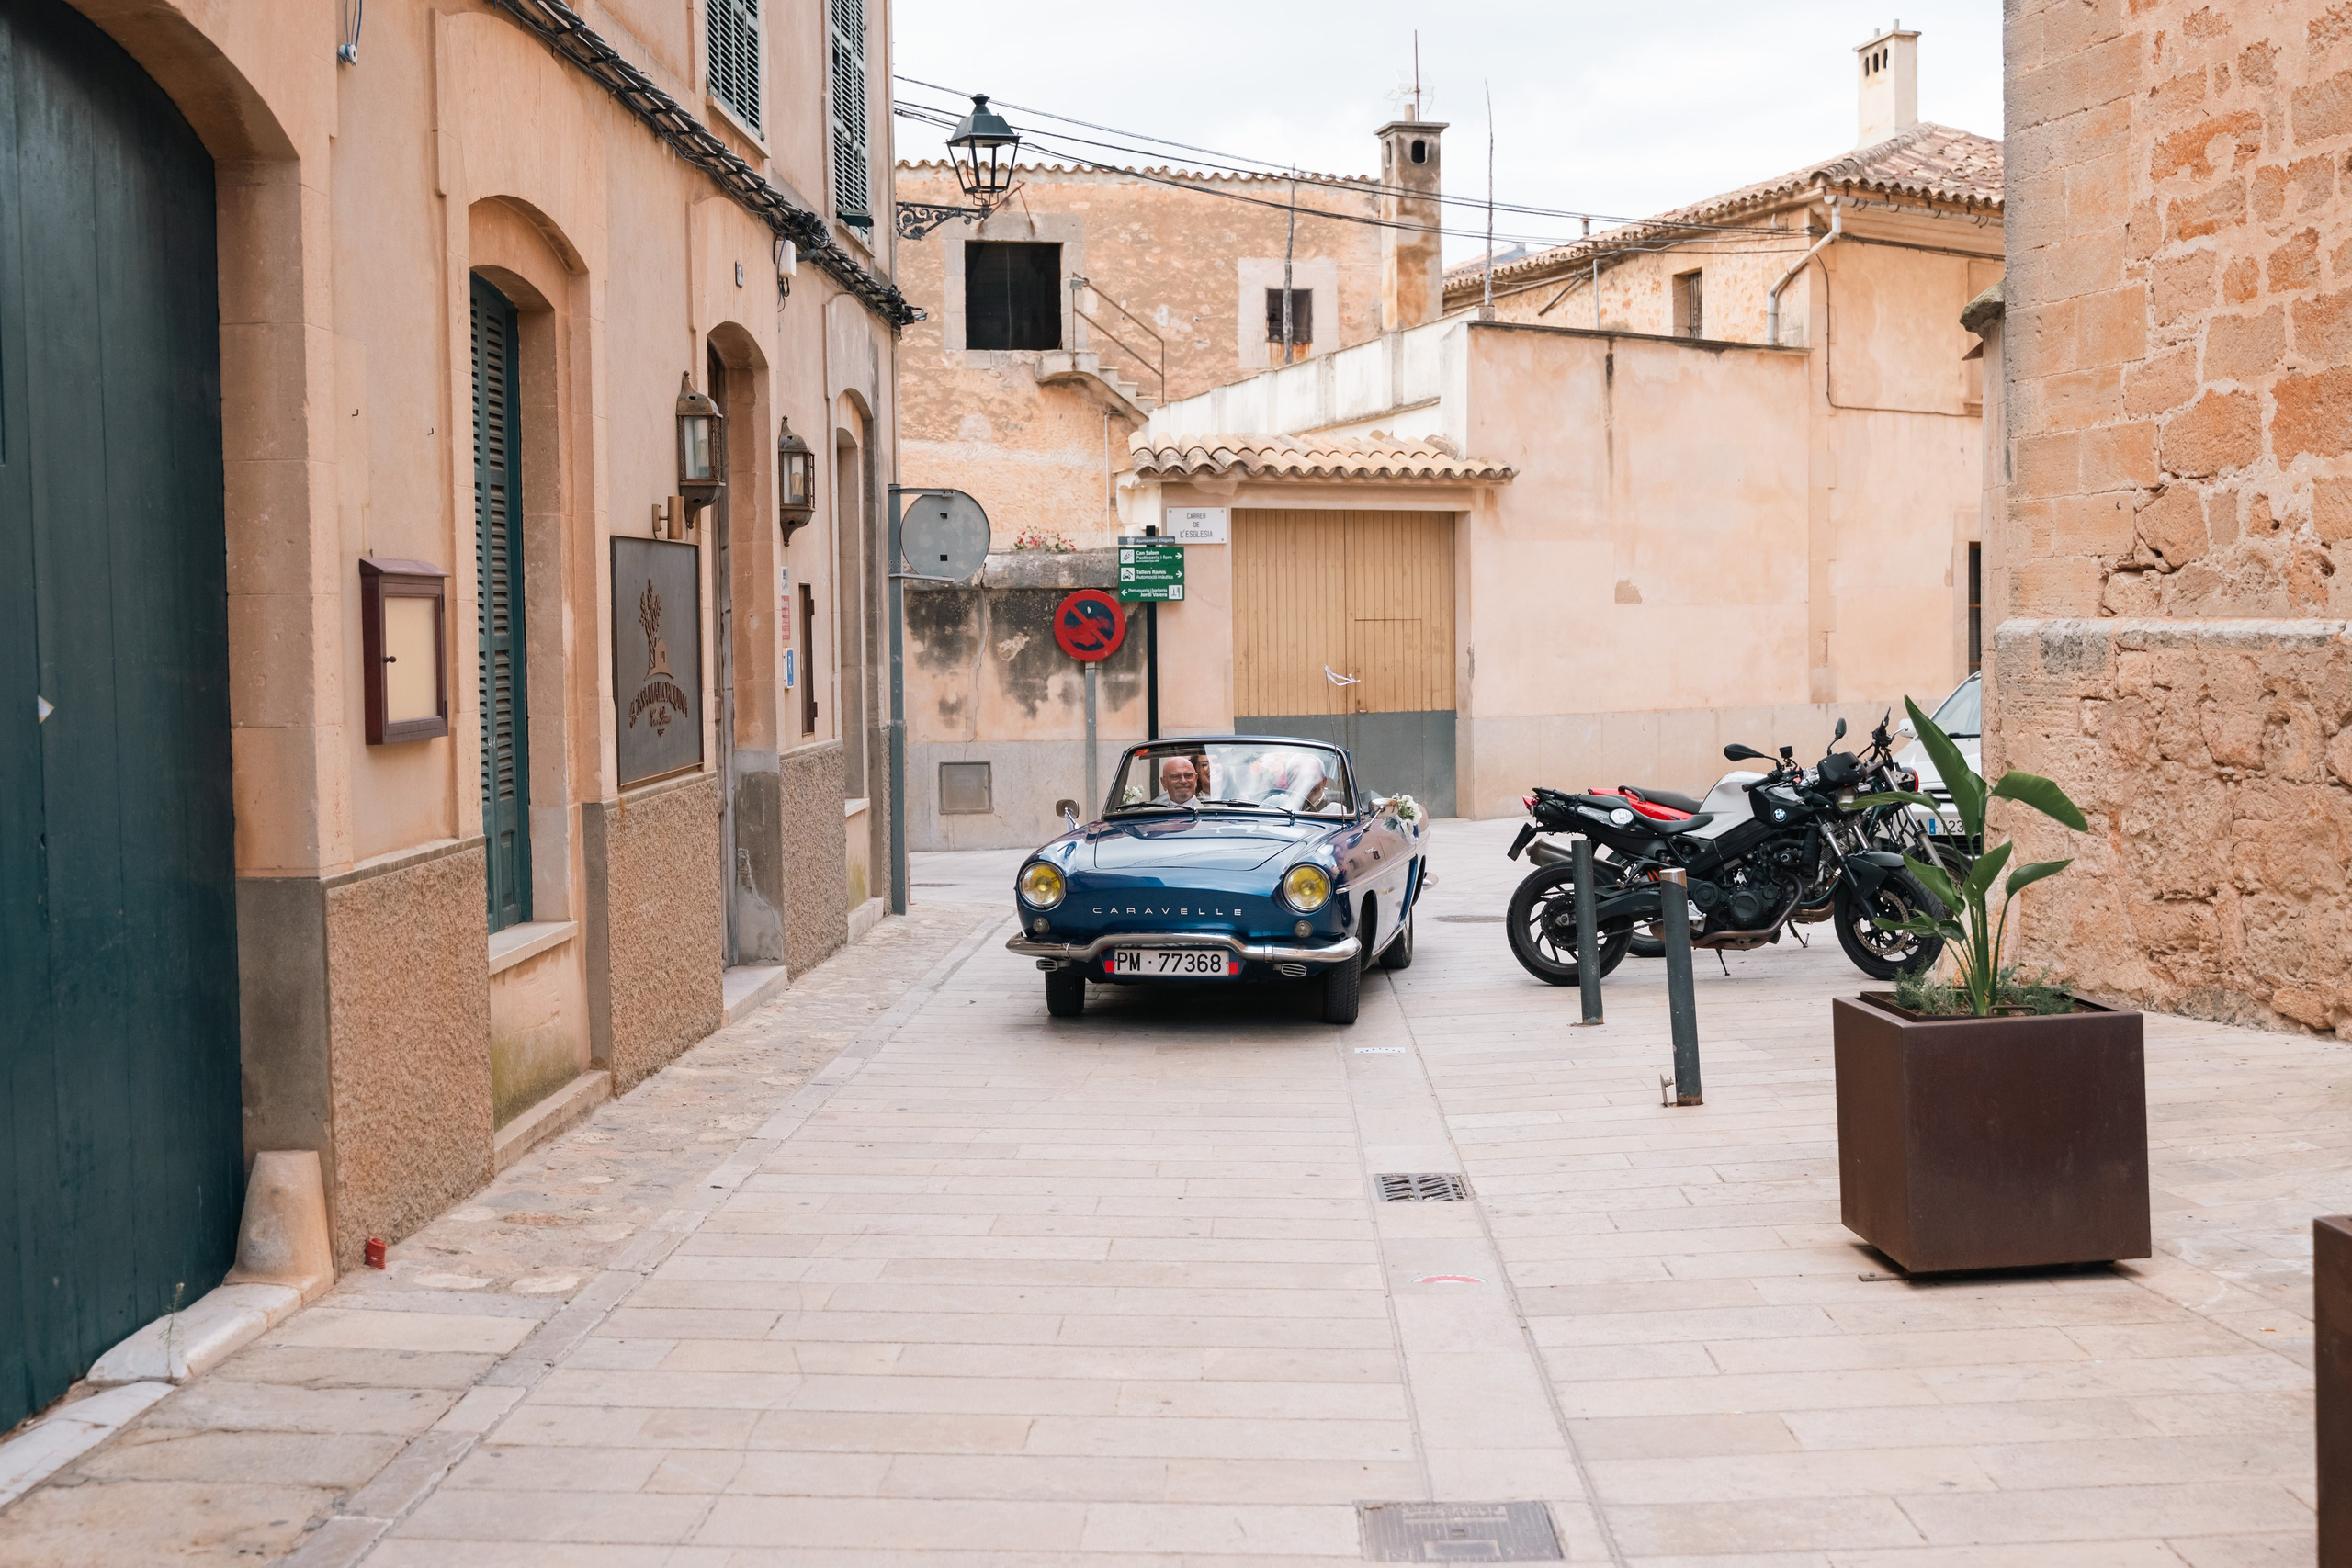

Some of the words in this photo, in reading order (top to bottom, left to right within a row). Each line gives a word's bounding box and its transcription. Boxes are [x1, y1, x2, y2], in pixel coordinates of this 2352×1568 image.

[1943, 820, 1965, 834] 123
[1093, 907, 1242, 915] CARAVELLE
[1117, 952, 1140, 971] PM
[1159, 953, 1221, 972] 77368
